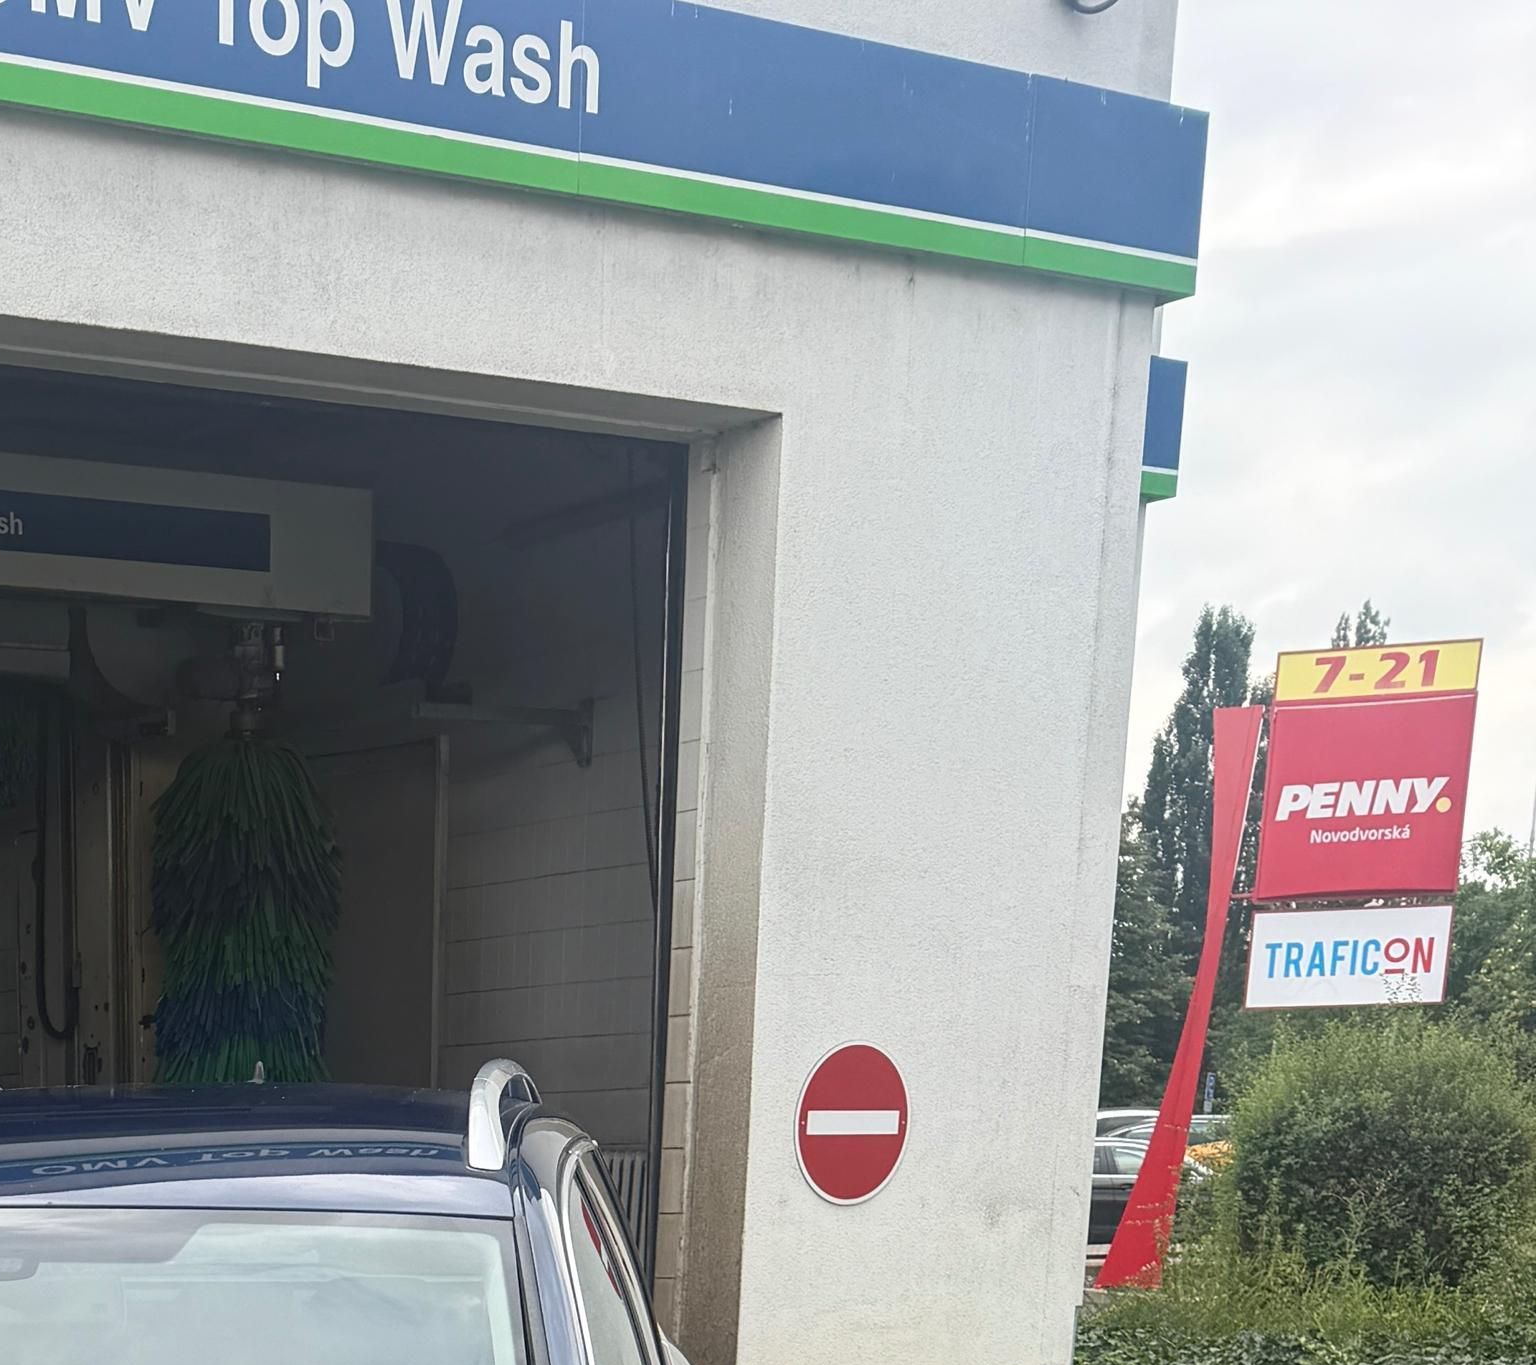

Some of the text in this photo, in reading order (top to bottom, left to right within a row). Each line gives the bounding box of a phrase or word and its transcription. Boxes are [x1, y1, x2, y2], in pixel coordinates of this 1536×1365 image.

[385, 0, 600, 115] Wash
[1313, 649, 1440, 694] 7-21
[1309, 825, 1411, 844] Novodvorská
[1265, 937, 1435, 979] TRAFICON
